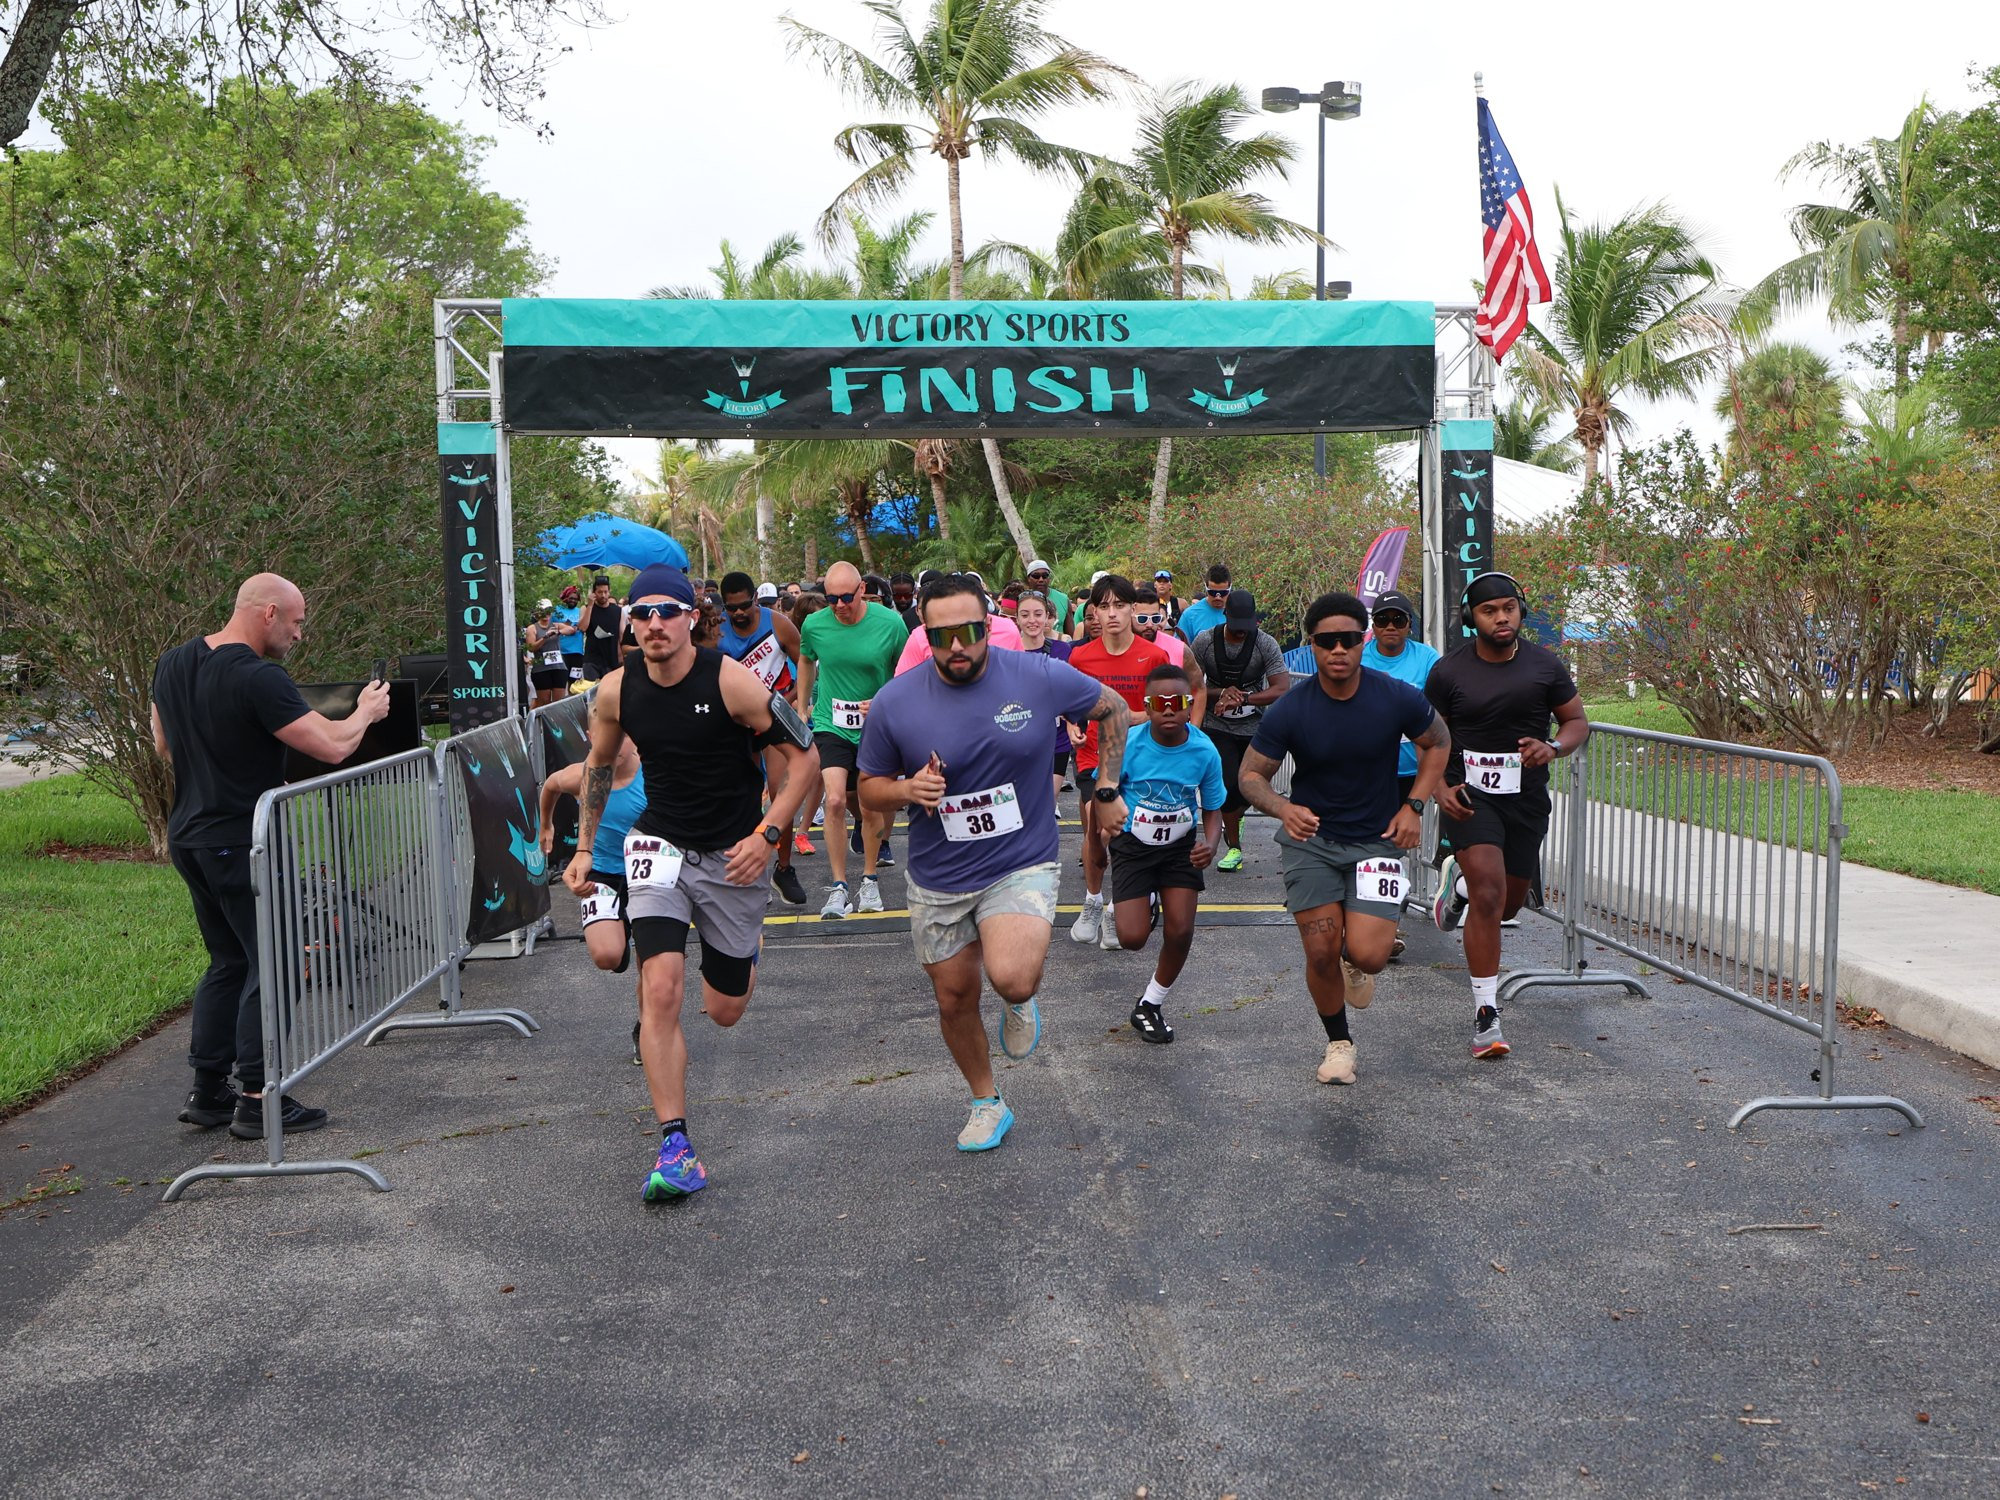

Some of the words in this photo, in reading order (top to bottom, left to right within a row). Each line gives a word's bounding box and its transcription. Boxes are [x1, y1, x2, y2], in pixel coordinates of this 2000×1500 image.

[851, 313, 993, 343] VICTORY
[1005, 313, 1130, 342] SPORTS
[826, 366, 1150, 415] FINISH
[725, 402, 765, 413] VICTORY
[1209, 400, 1248, 411] VICTORY
[458, 496, 490, 680] VICTORY
[741, 642, 773, 669] DENTS
[453, 686, 505, 699] SPORTS
[846, 713, 860, 726] 81
[993, 710, 1033, 724] YOSEMITE
[1481, 771, 1502, 789] 42
[966, 812, 996, 835] 38
[1152, 827, 1171, 842] 41
[631, 858, 653, 880] 23
[1378, 878, 1399, 898] 86
[582, 900, 598, 921] 94
